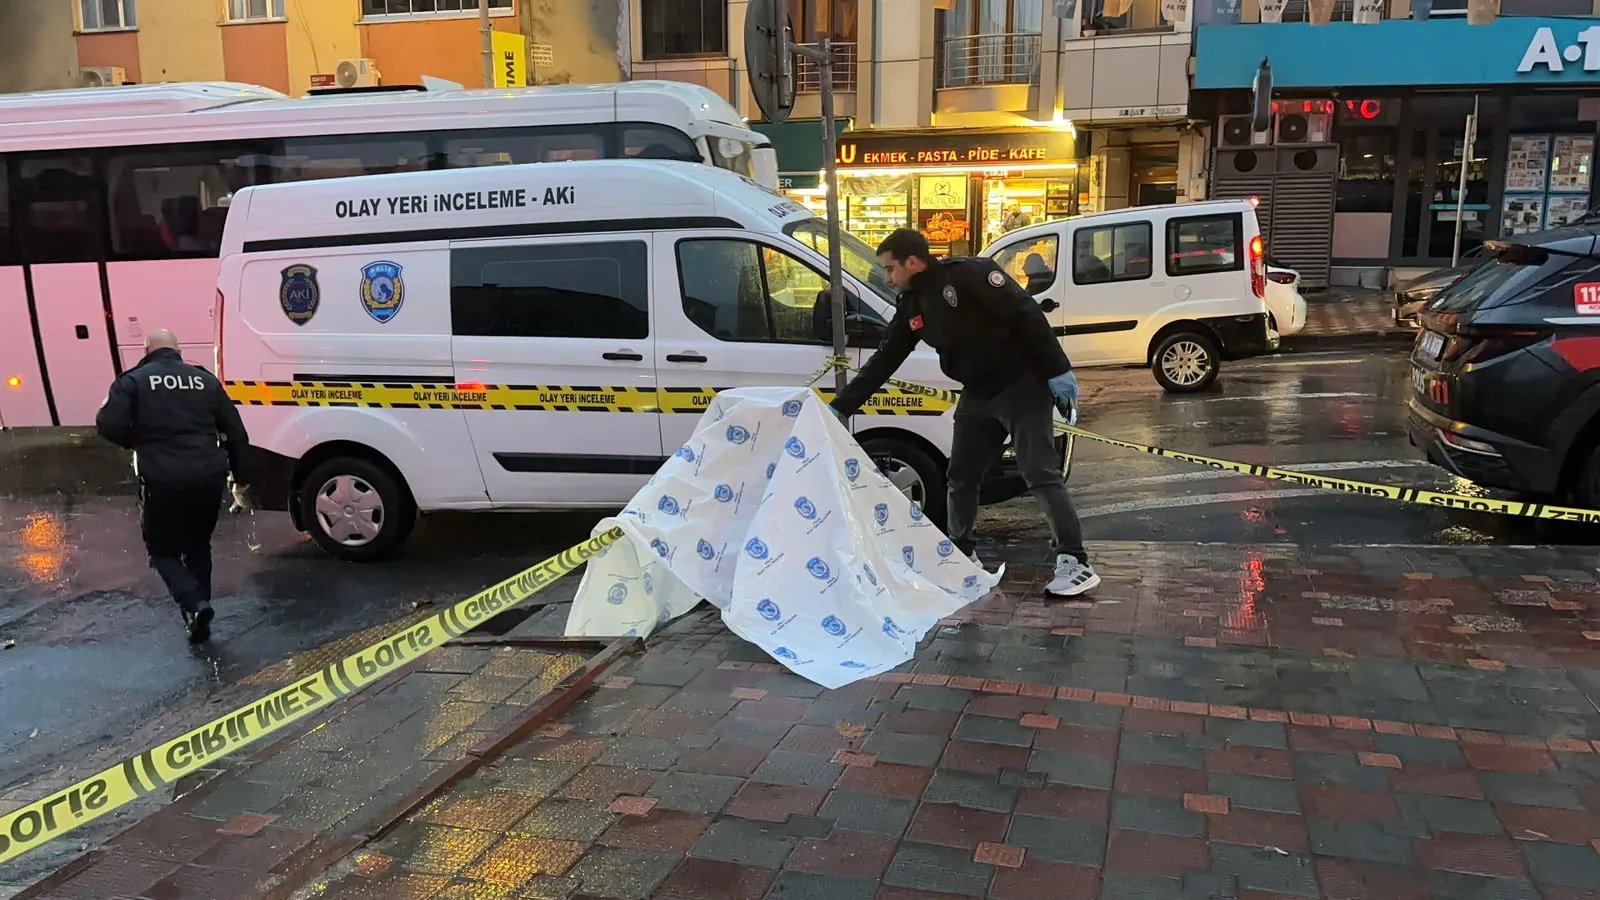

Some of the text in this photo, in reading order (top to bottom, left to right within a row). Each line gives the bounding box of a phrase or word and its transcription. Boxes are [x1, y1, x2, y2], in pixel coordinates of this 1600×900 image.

[503, 50, 516, 88] IME
[835, 144, 856, 164] U
[864, 152, 907, 164] EKMEK
[918, 150, 958, 162] PASTA
[1009, 148, 1046, 160] KAFE
[335, 198, 381, 218] OLAY
[291, 389, 310, 399] OLAY
[413, 391, 432, 401] OLAY
[540, 393, 559, 403] OLAY
[692, 395, 713, 406] OLAY
